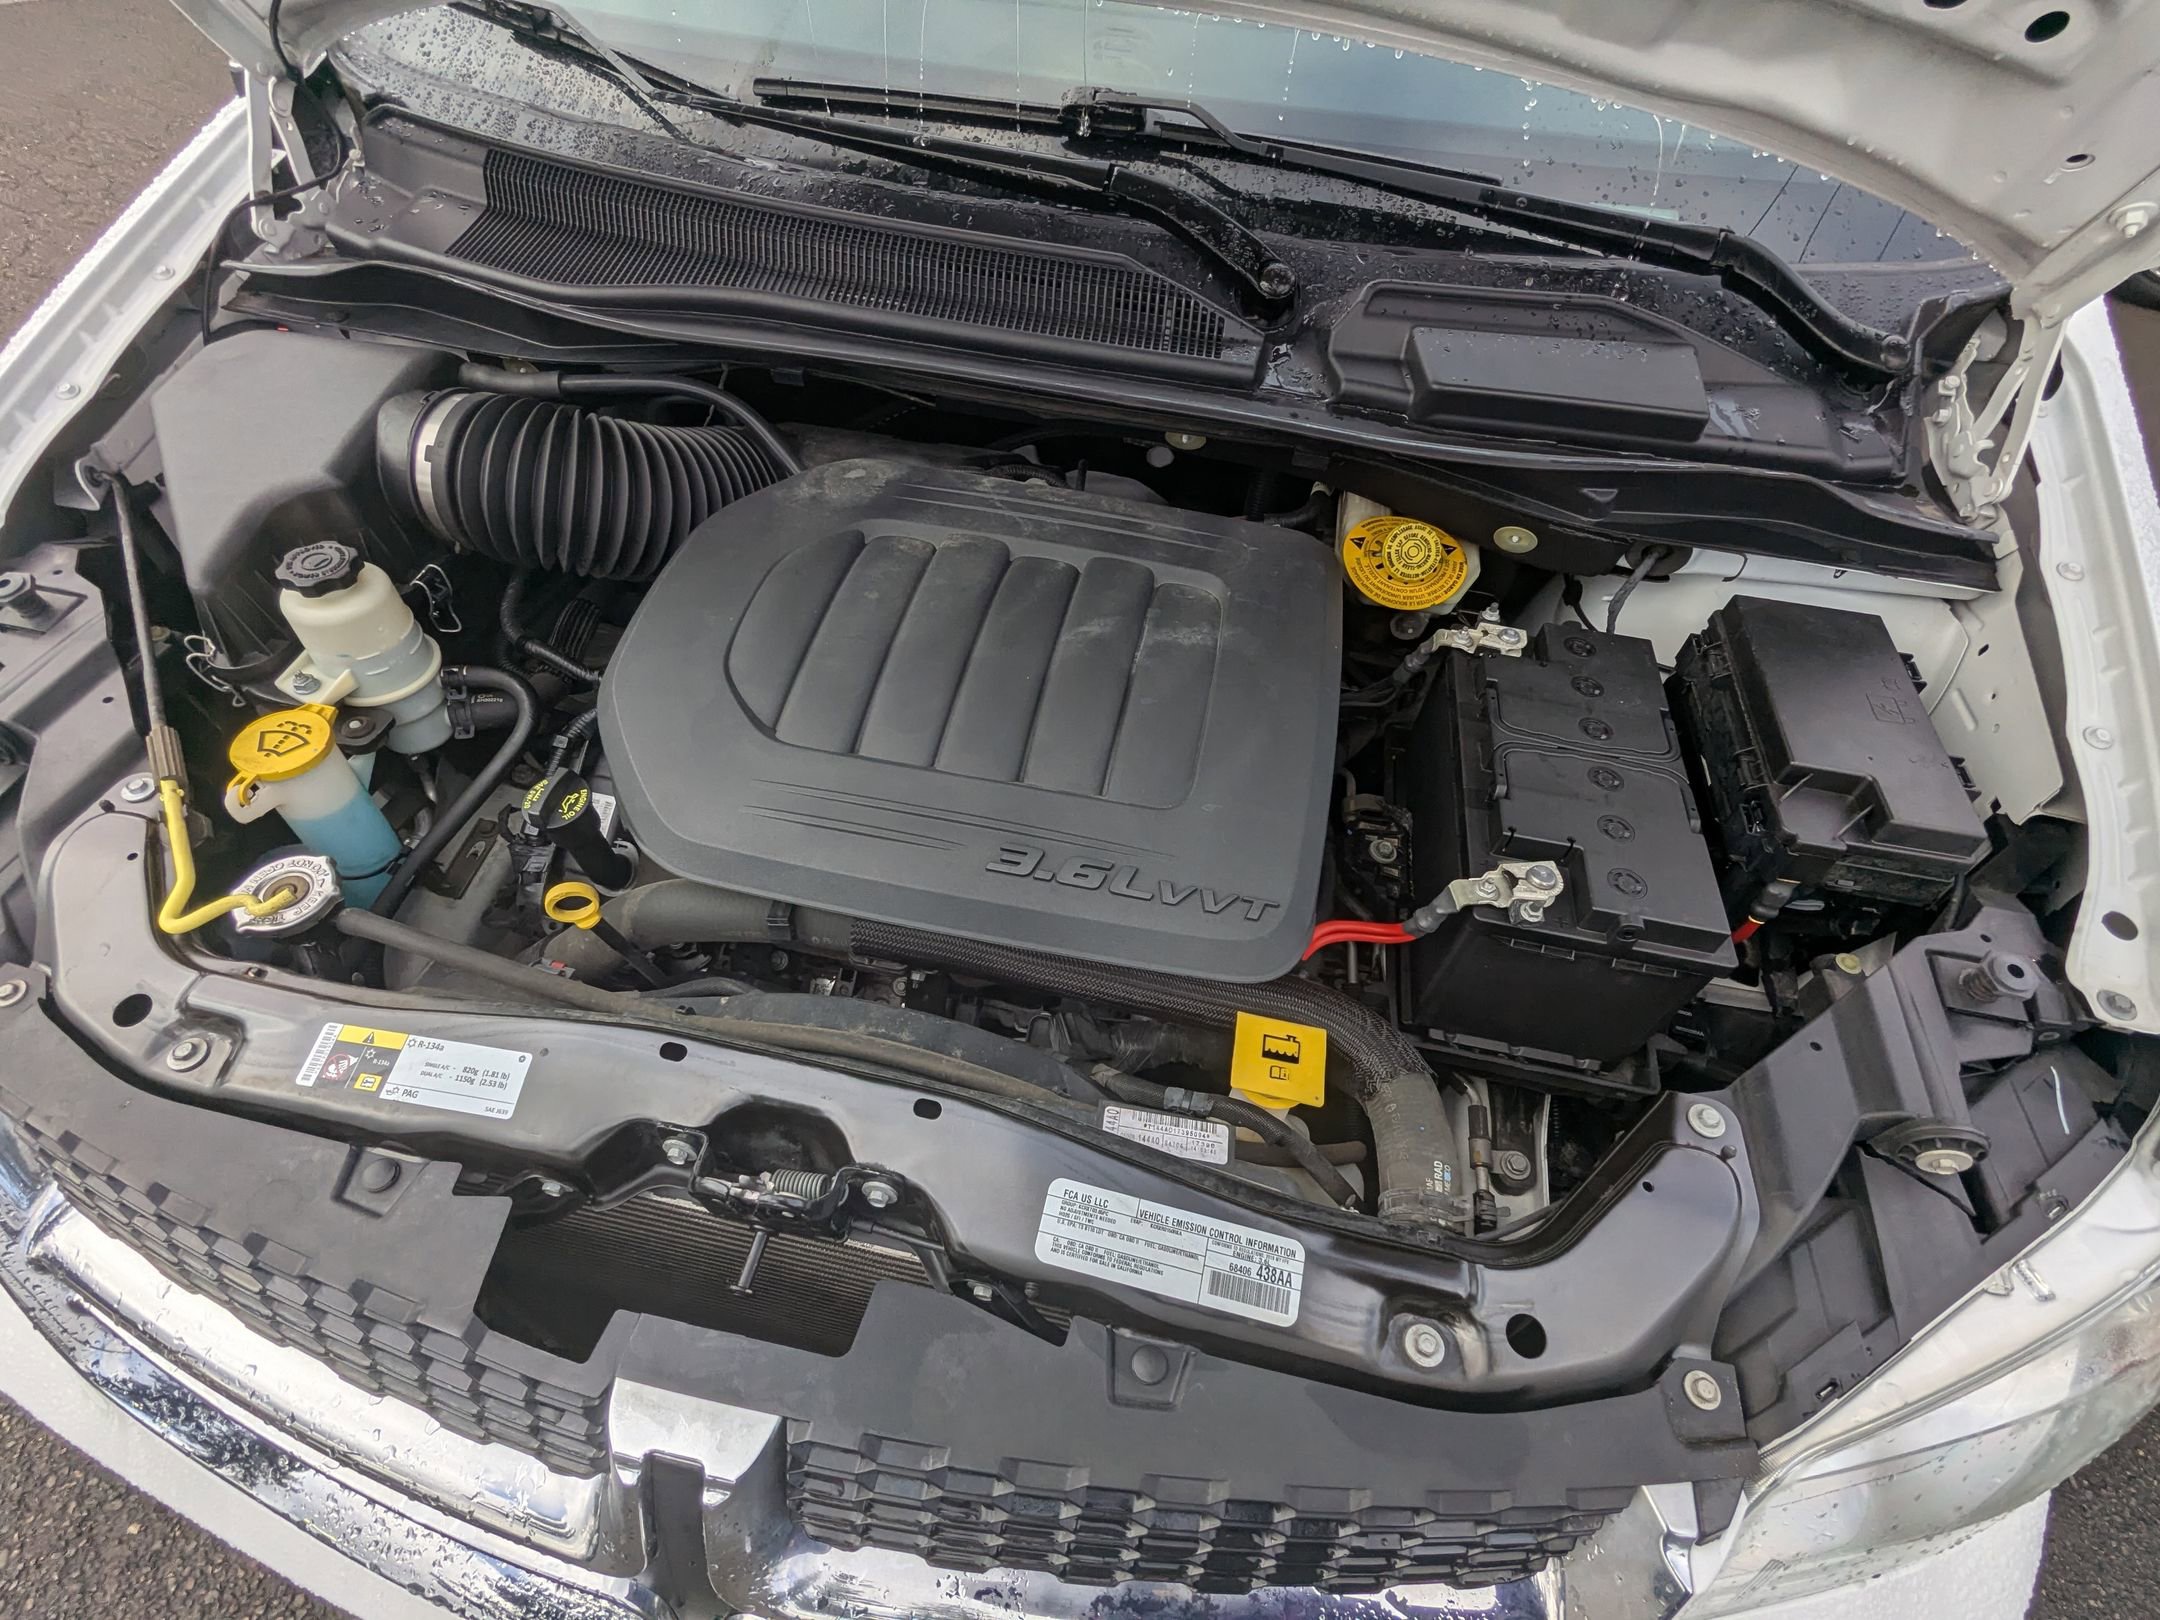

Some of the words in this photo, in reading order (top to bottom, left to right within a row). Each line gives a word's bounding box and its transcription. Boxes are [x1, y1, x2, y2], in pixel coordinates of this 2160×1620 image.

[574, 789, 588, 812] ENGINE
[562, 811, 576, 820] OIL
[293, 890, 325, 916] KEEP
[418, 1040, 444, 1051] R-134a
[424, 1062, 440, 1070] SINGLE
[462, 1066, 480, 1076] 820g
[482, 1069, 500, 1078] (1.81
[500, 1072, 510, 1081] lb)
[455, 1074, 476, 1086] 1150g
[479, 1078, 497, 1088] (2.53
[498, 1082, 508, 1090] lb)
[402, 1088, 419, 1099] PAG
[1434, 1160, 1442, 1180] RAD
[1064, 1189, 1078, 1200] FCA
[1081, 1194, 1092, 1204] US
[1094, 1197, 1108, 1208] LLC
[1068, 1208, 1098, 1220] ADJUSTMENTS
[1099, 1216, 1116, 1224] NEEDED
[1140, 1209, 1169, 1224] VEHICLE
[1172, 1218, 1207, 1234] EMISSION
[1210, 1228, 1243, 1244] CONTROL
[1246, 1238, 1296, 1258] INFORMATION
[1063, 1244, 1080, 1254] VEHICLE
[1082, 1249, 1106, 1260] CONFORMS
[1113, 1256, 1132, 1268] FEDERAL
[1133, 1261, 1164, 1276] REGULATIONS
[1066, 1251, 1088, 1262] CERTIFIED
[1090, 1256, 1098, 1264] FOR
[1099, 1259, 1110, 1268] SALE
[1116, 1264, 1143, 1276] CALIFORNIA
[1232, 1251, 1257, 1262] ENGINE:
[1230, 1262, 1252, 1276] 68406
[1256, 1265, 1292, 1288] 438AA
